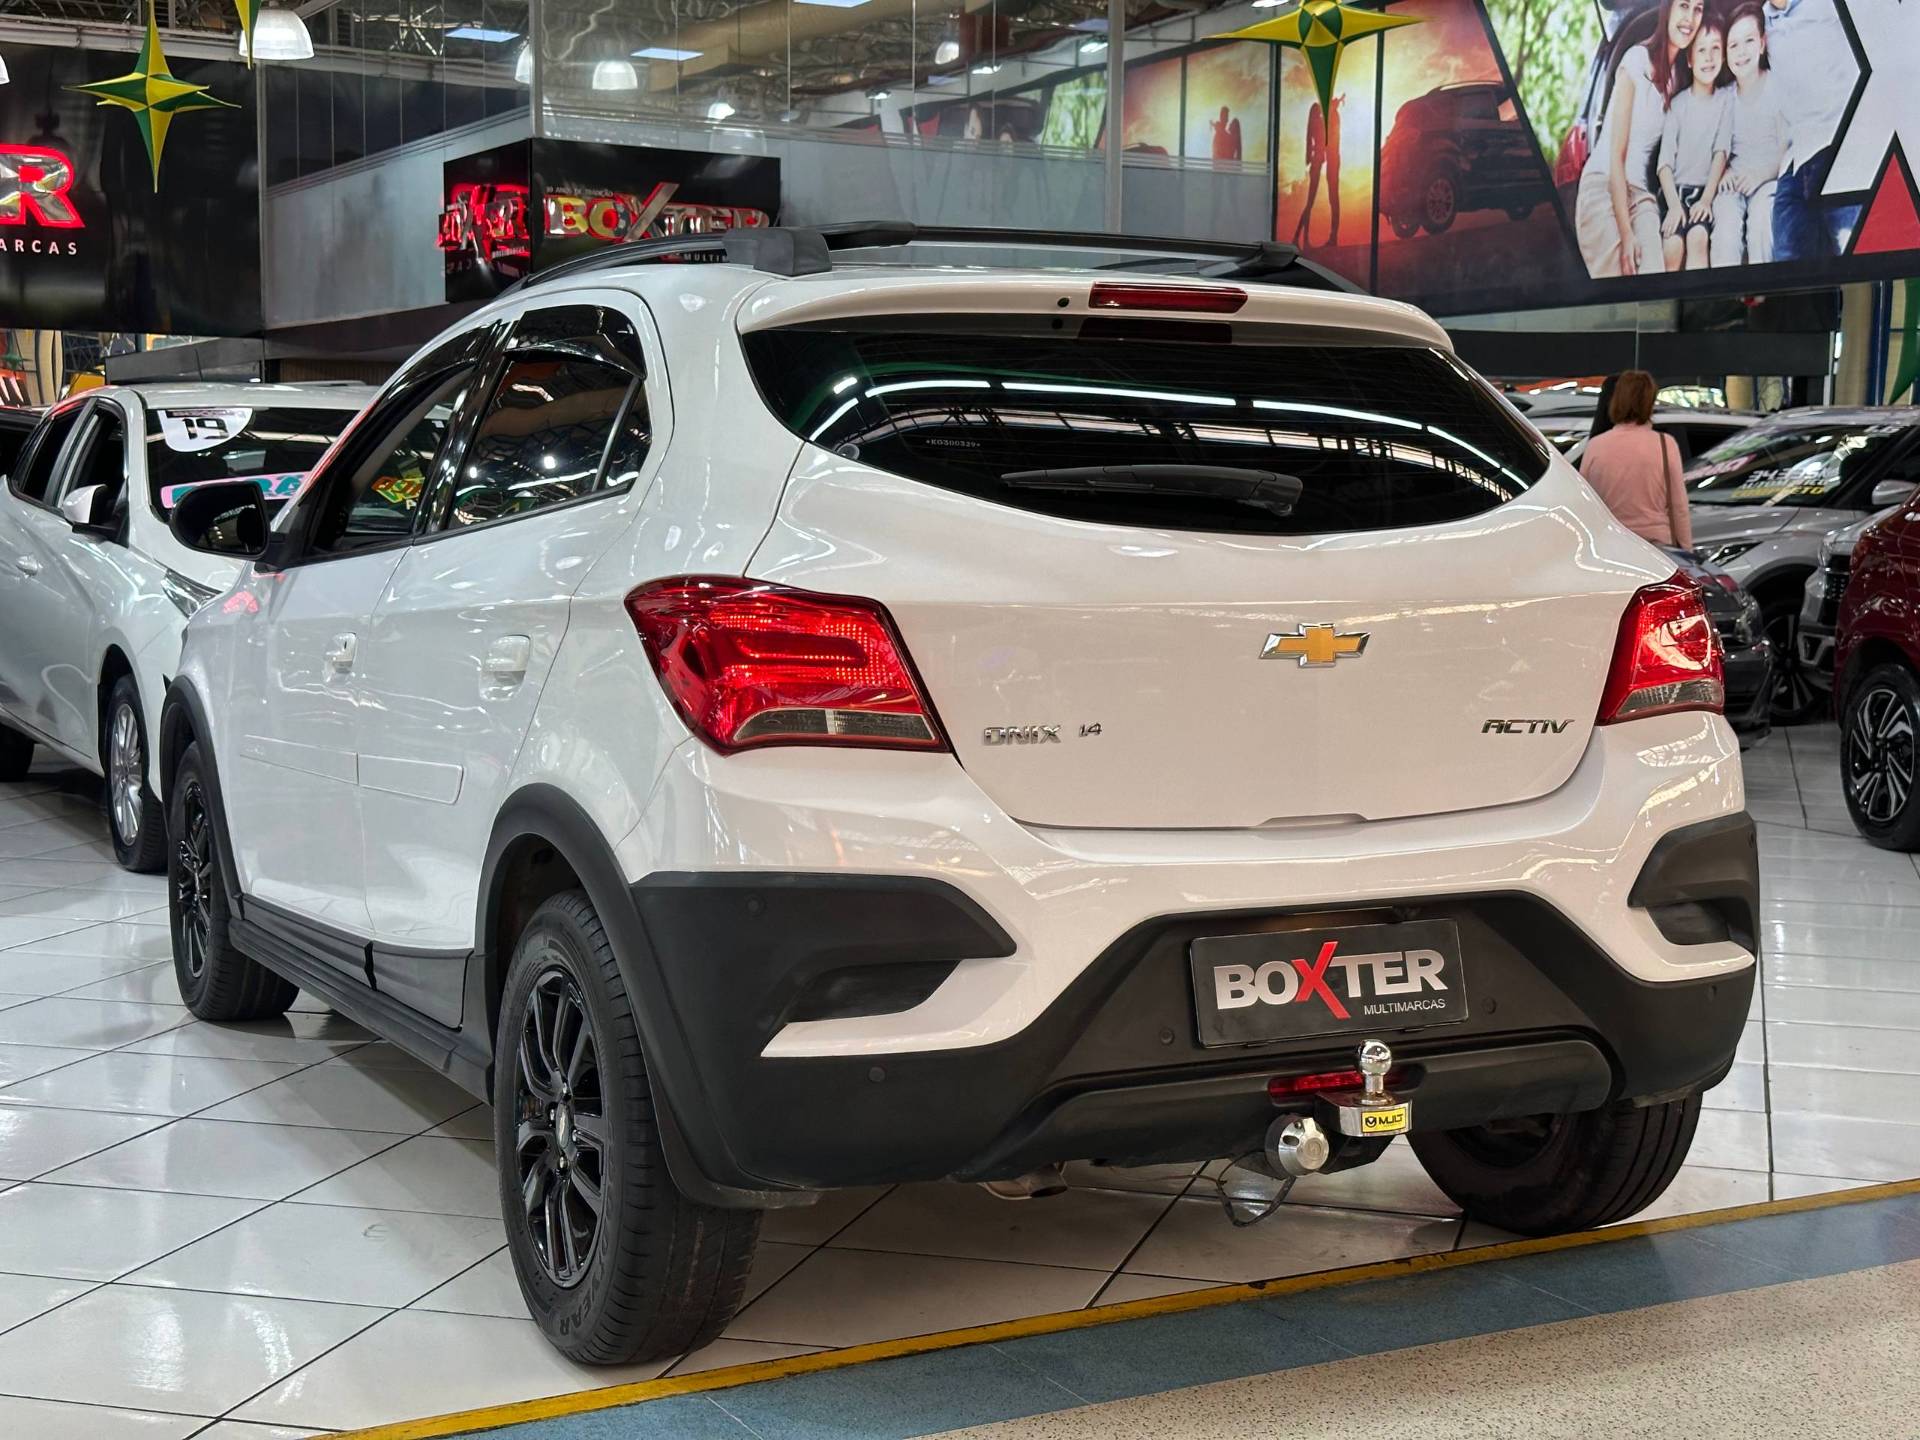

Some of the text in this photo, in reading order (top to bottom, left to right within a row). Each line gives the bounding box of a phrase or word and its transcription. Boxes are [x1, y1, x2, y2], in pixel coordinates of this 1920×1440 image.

[983, 725, 1062, 745] ONIX
[1481, 719, 1575, 733] ACTIV
[1213, 941, 1449, 1019] BOXTER
[1364, 998, 1446, 1015] MULTIMARCAS
